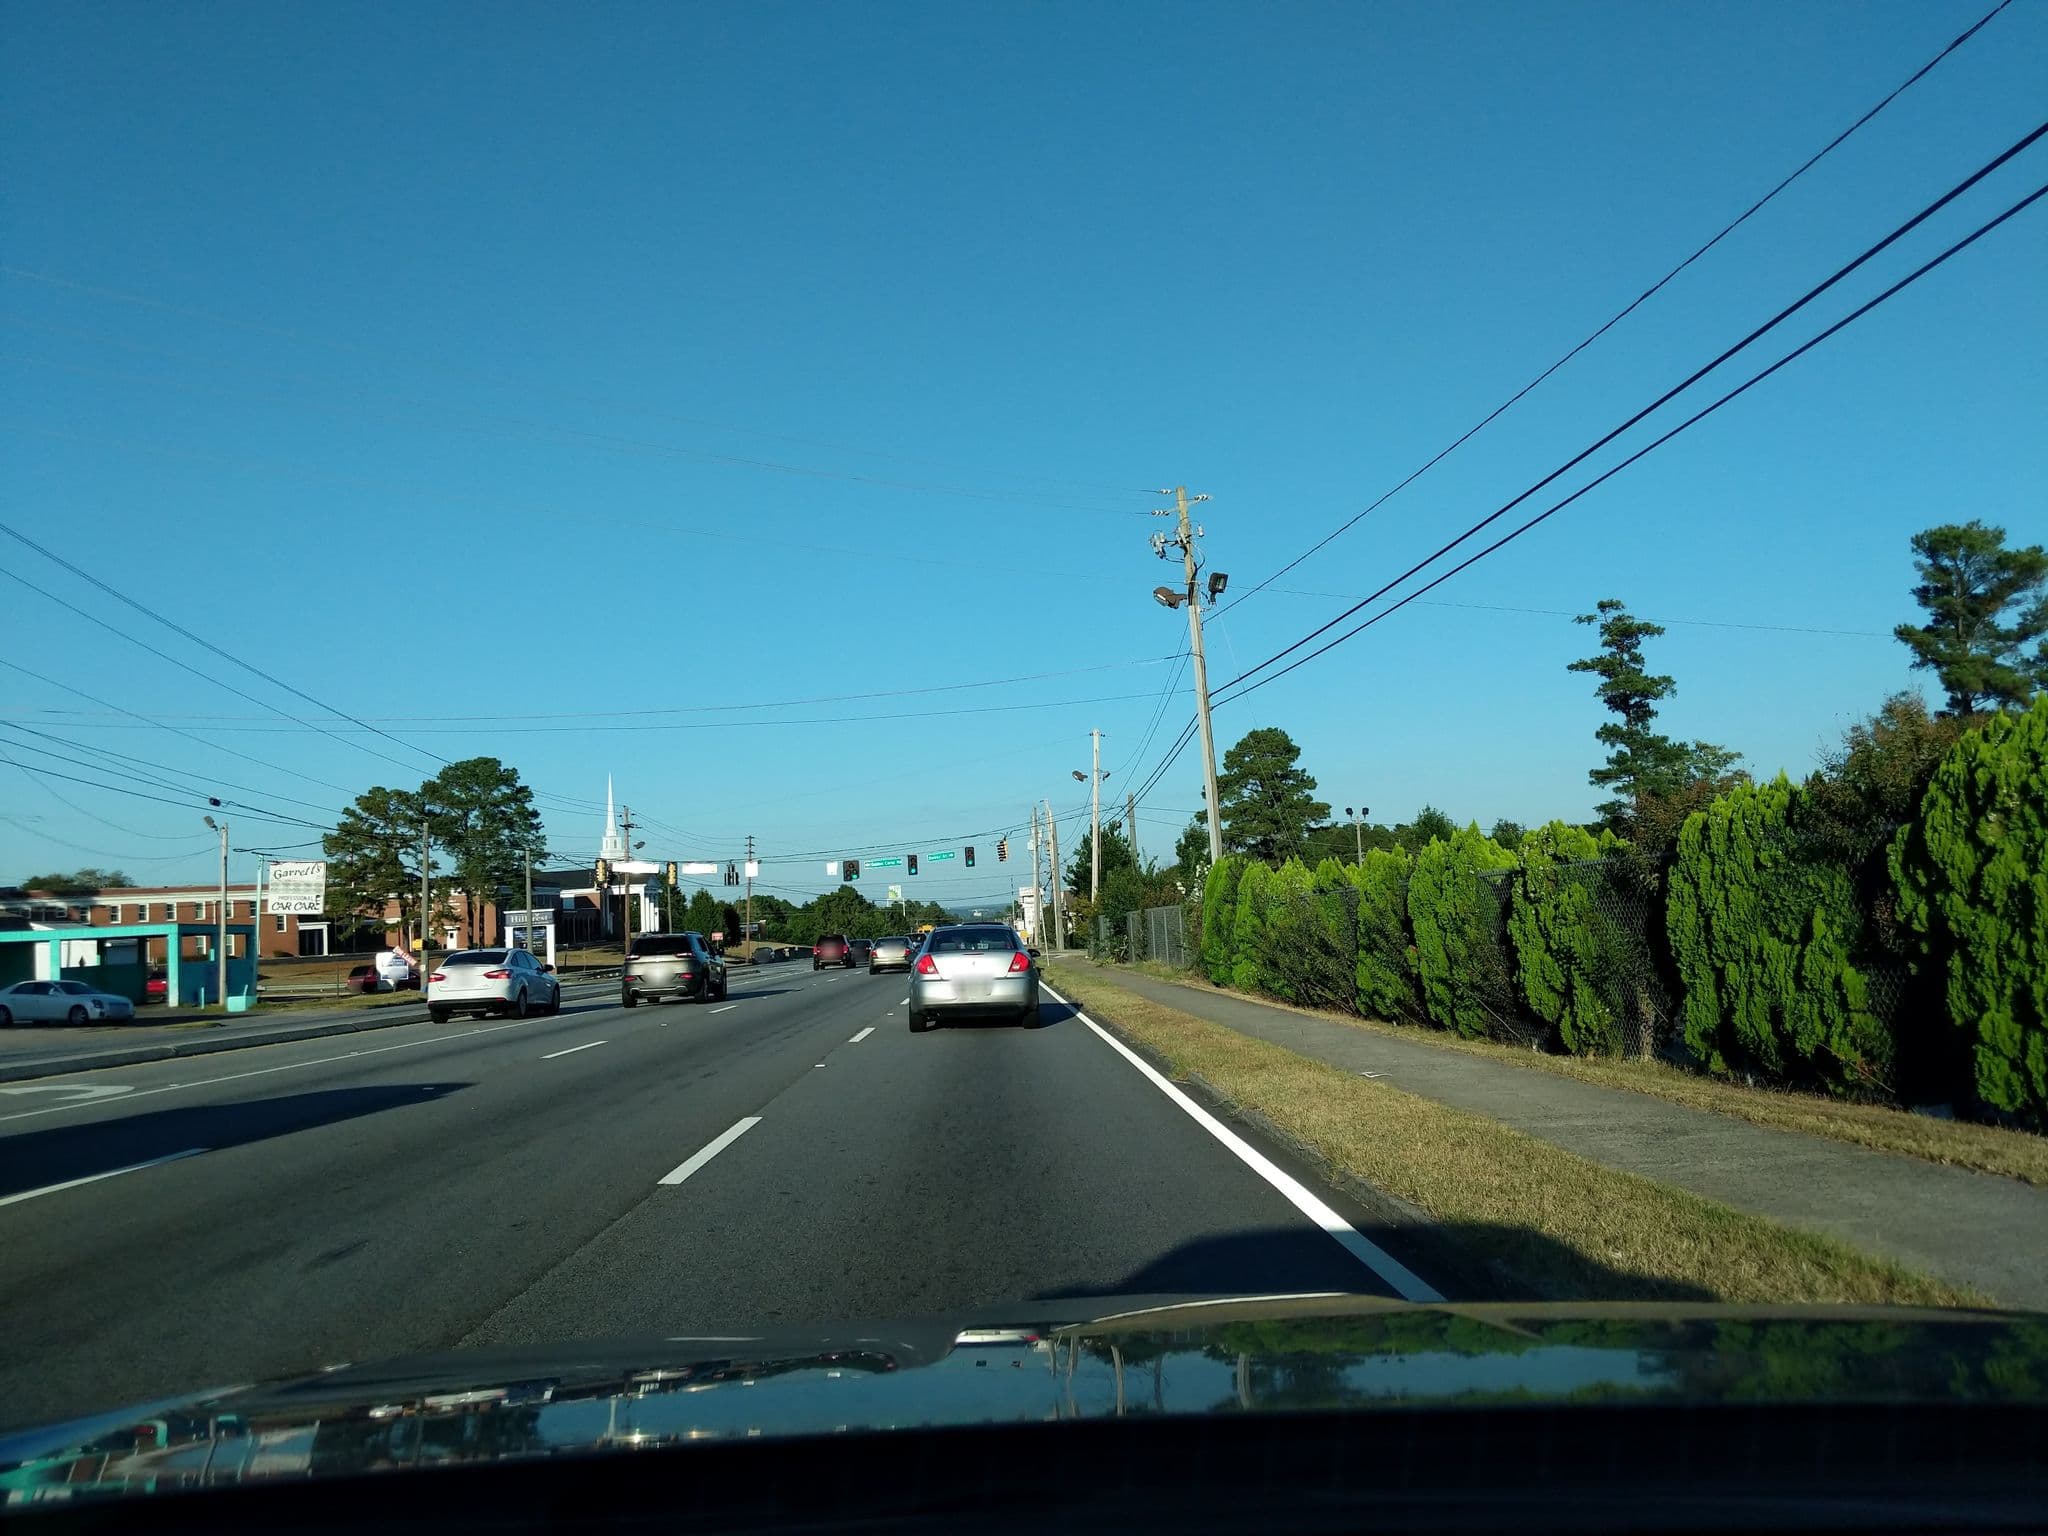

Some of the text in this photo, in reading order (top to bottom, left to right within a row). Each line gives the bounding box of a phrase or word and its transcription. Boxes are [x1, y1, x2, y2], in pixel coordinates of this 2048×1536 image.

[271, 895, 321, 911] CAR CARE
[511, 913, 548, 923] Hillrest
